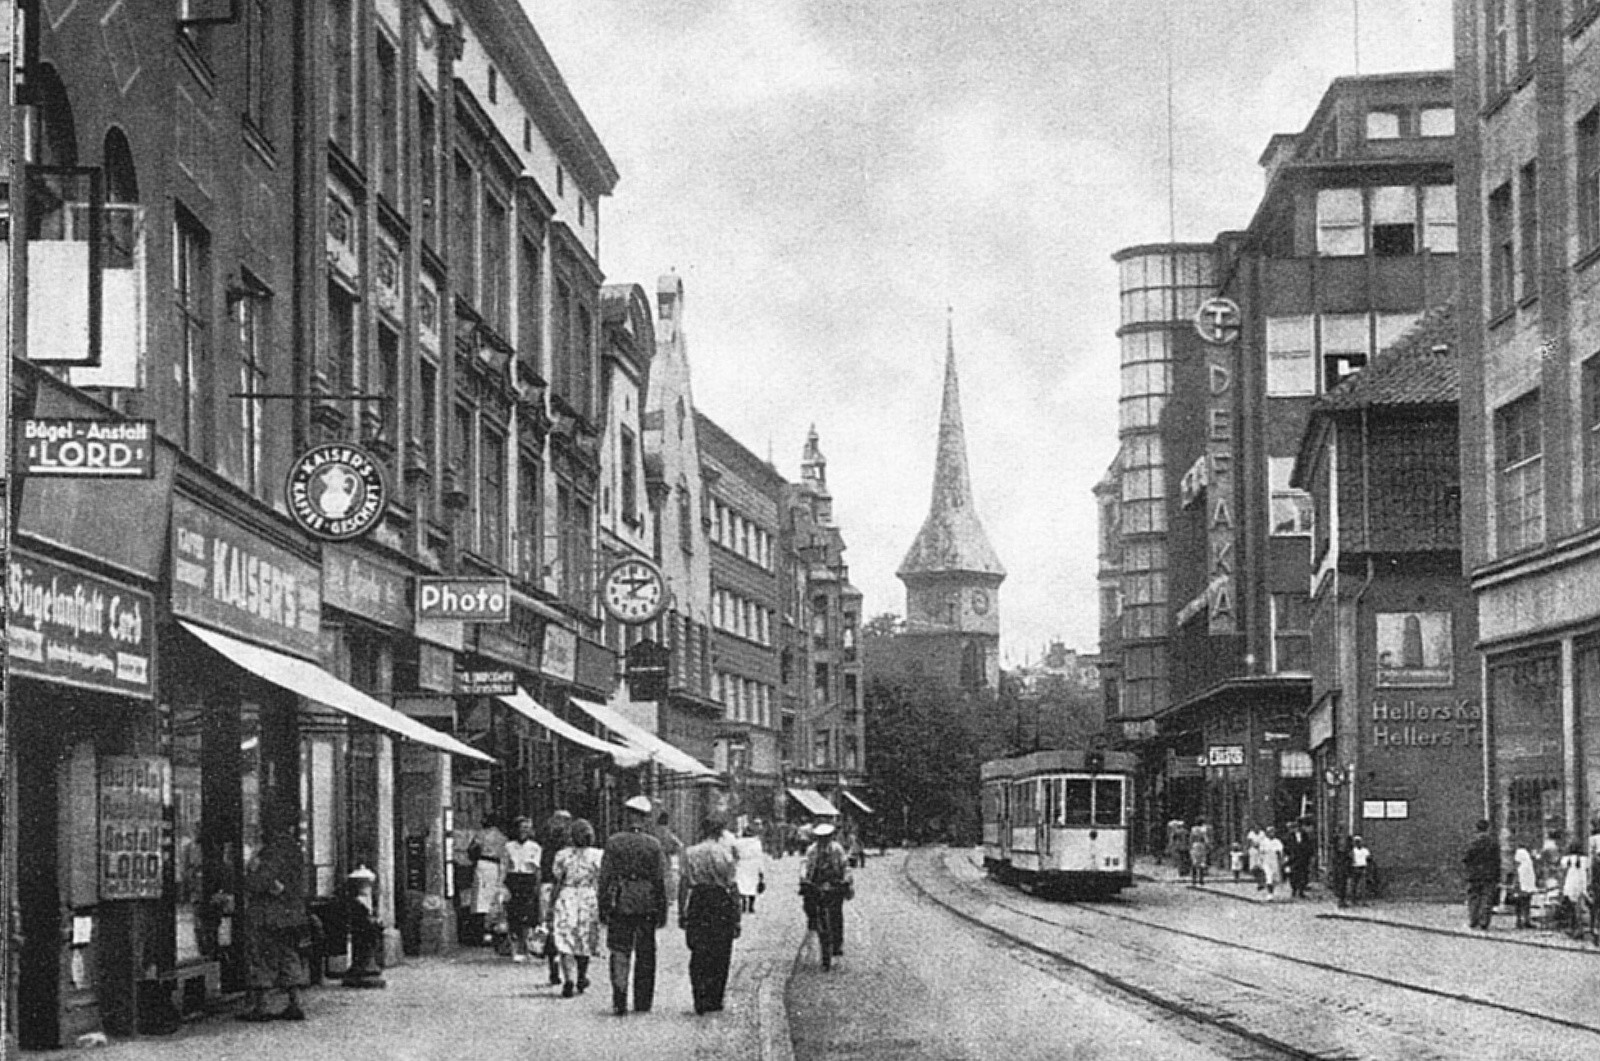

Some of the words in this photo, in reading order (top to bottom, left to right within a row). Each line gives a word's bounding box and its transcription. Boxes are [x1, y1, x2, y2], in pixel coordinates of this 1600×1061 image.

[87, 422, 148, 440] Anstalt
[301, 448, 373, 476] KAISER'S
[422, 584, 504, 613] Photo
[1373, 700, 1451, 720] Hellers
[1373, 725, 1452, 746] Hellers
